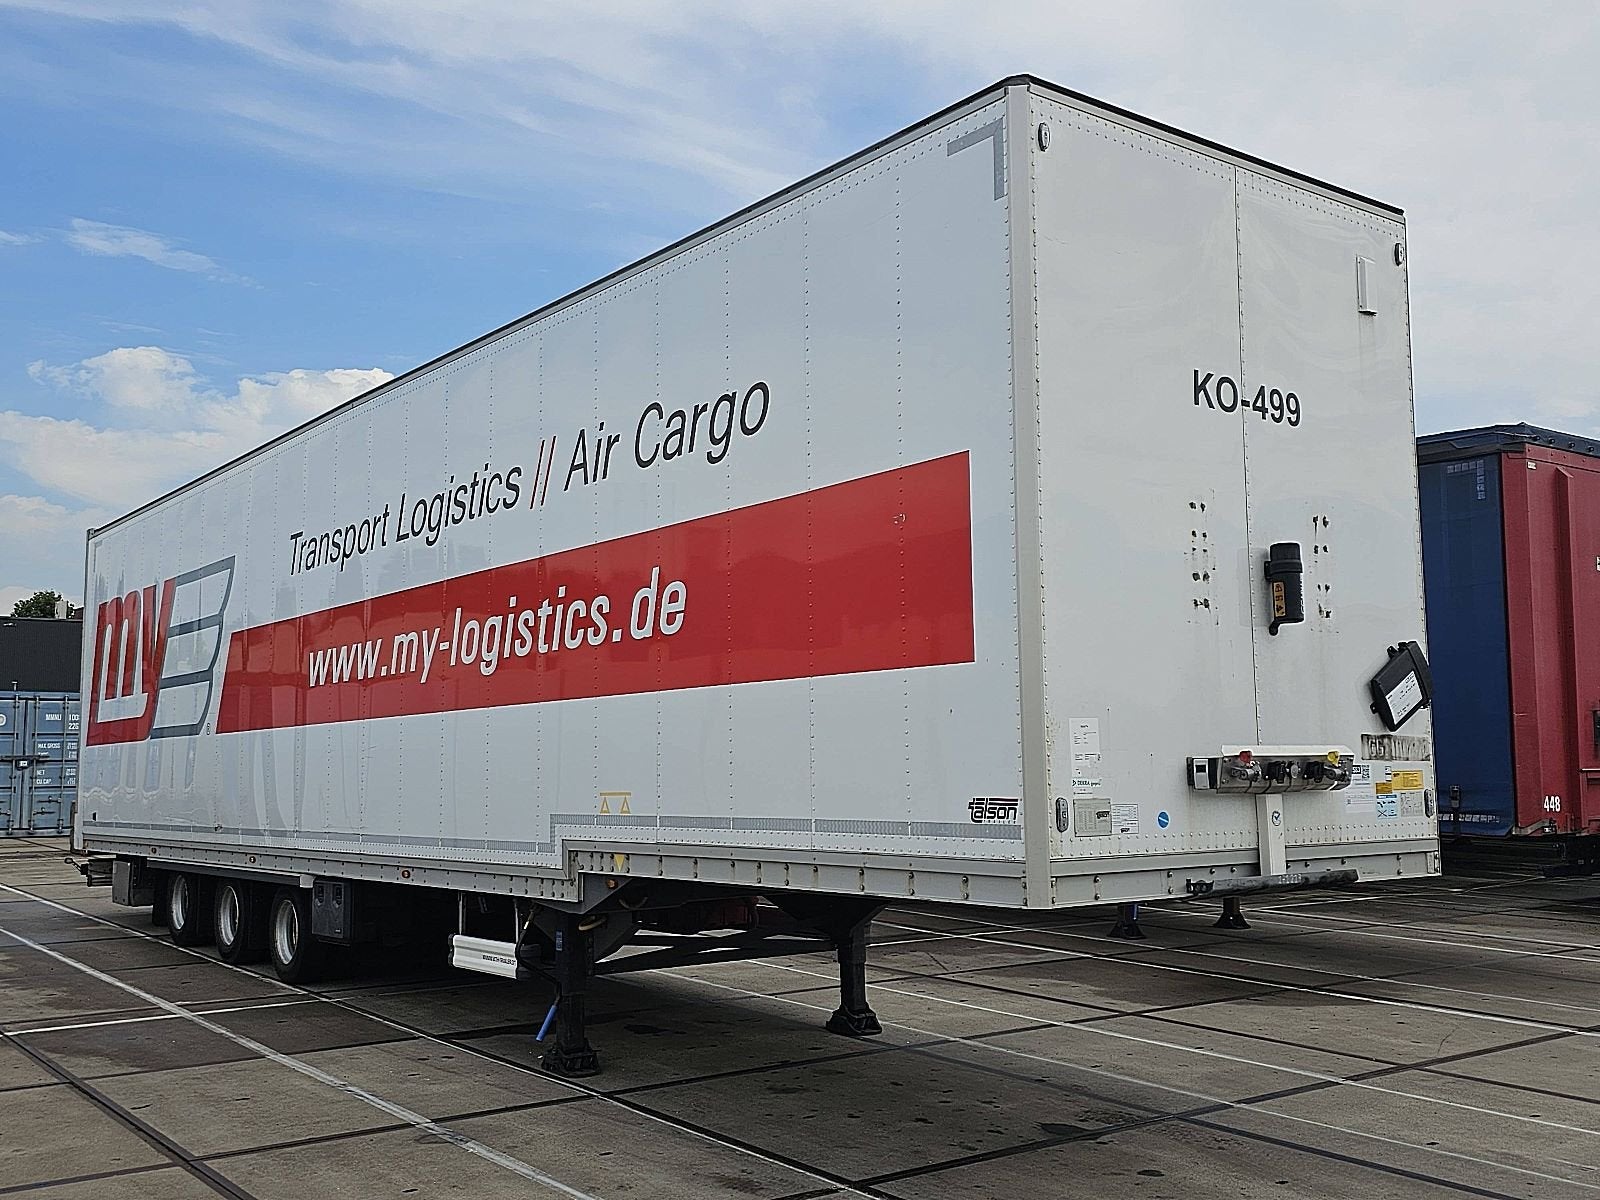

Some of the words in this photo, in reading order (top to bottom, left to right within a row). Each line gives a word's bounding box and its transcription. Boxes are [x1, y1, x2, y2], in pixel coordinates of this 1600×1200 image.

[1193, 369, 1301, 427] KO-499
[290, 504, 390, 576] Transport
[396, 462, 523, 547] Logistics
[564, 421, 620, 492] Air
[634, 381, 771, 464] Cargo
[308, 566, 688, 687] www.my-logistics.de
[967, 798, 1018, 823] talson
[1543, 795, 1561, 812] 448
